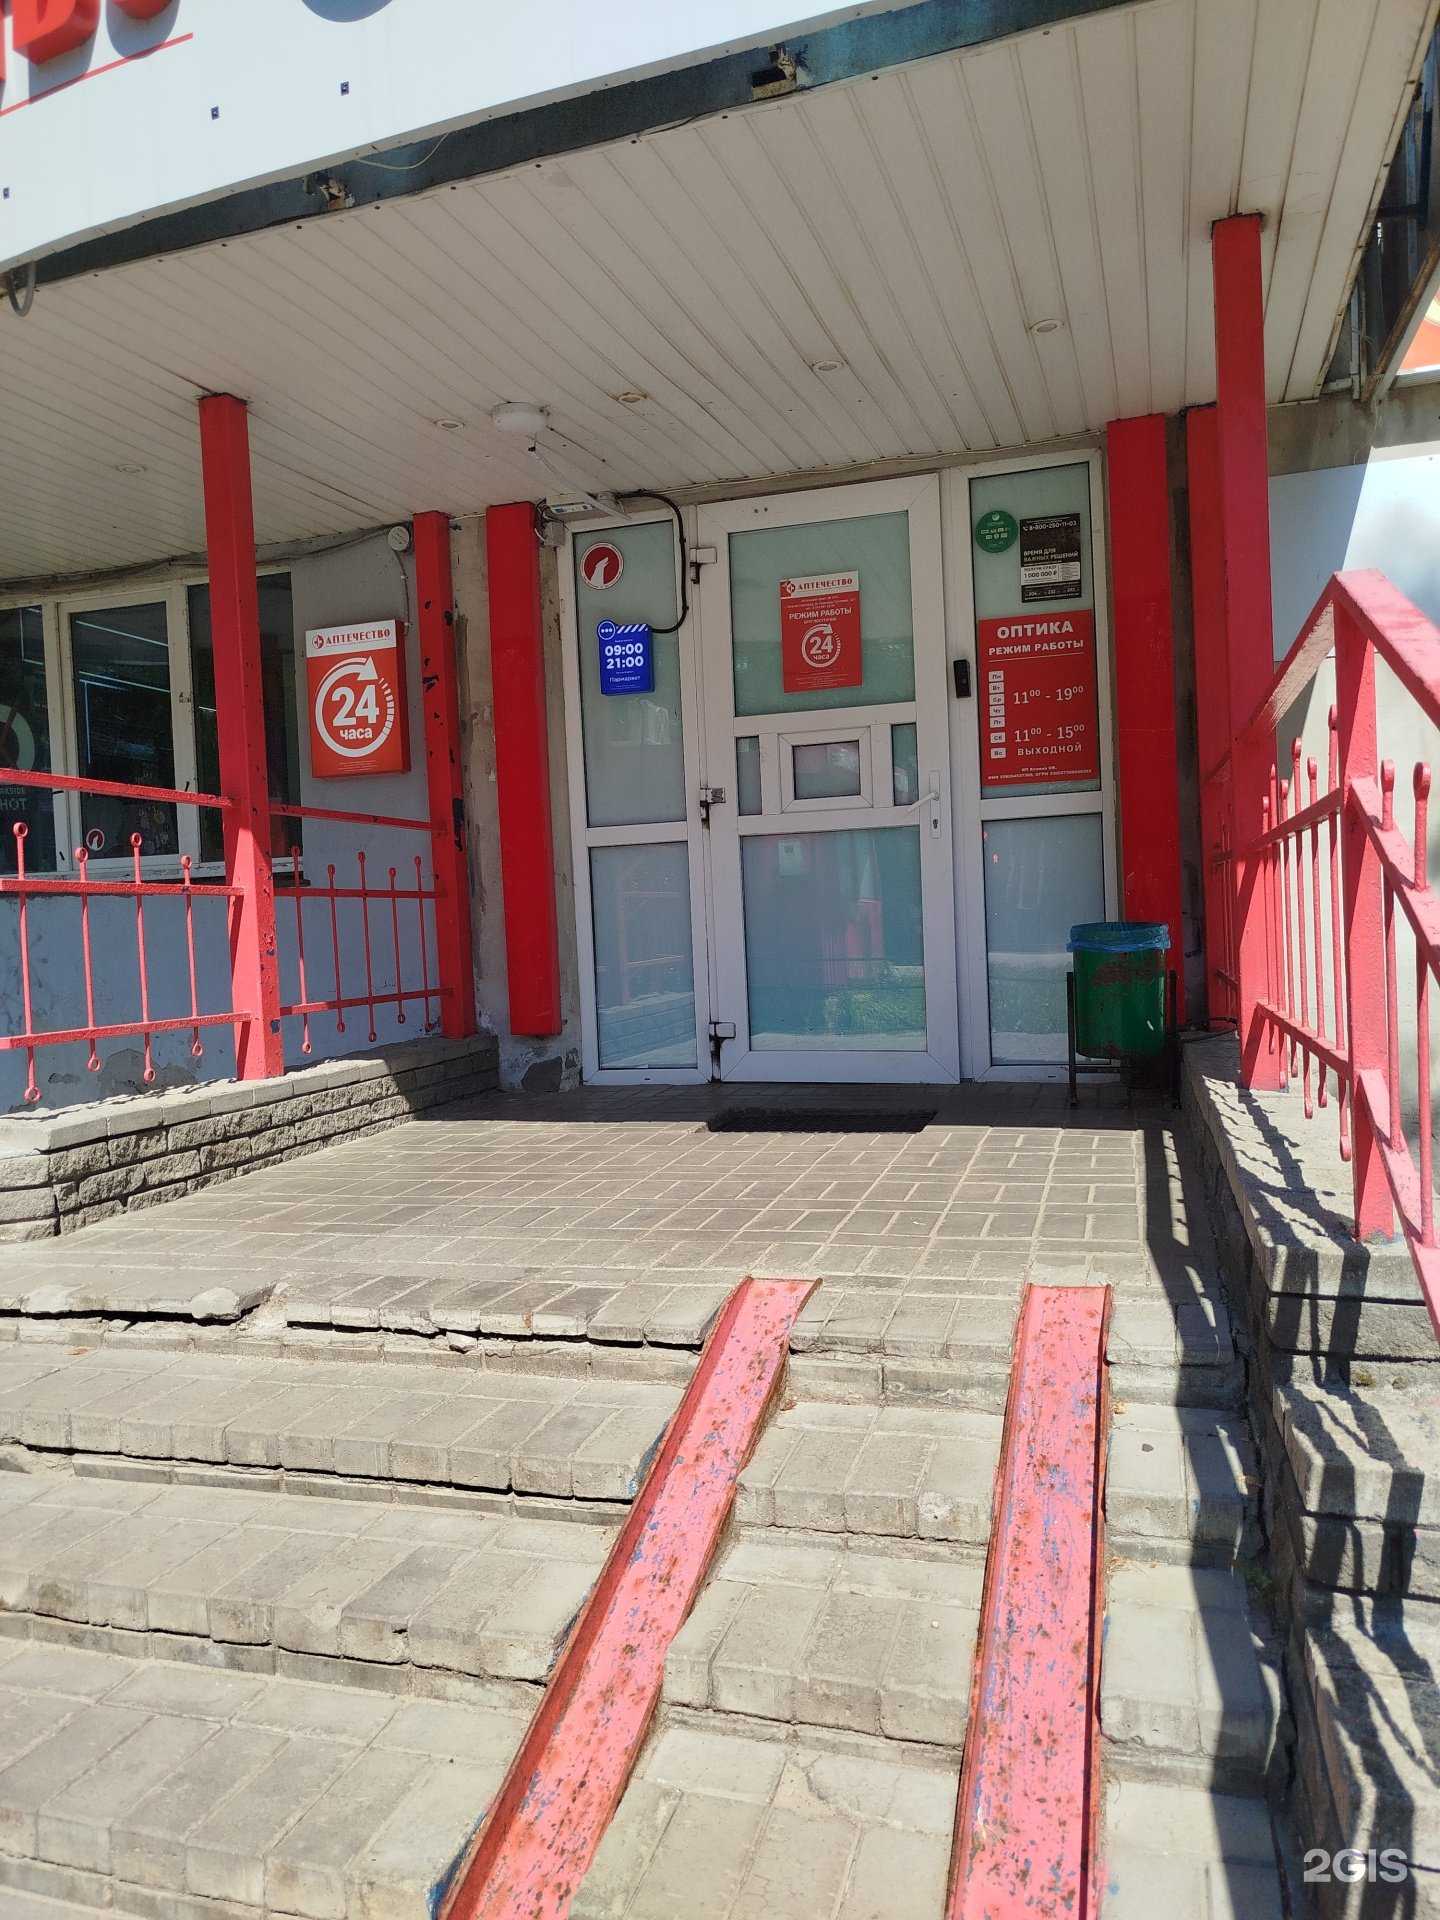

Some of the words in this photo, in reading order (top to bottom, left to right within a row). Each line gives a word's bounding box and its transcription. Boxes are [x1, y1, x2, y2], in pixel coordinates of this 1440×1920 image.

[798, 578, 853, 591] АПТЕЧЕСТВО
[789, 610, 819, 620] РЕЖИМ
[820, 607, 852, 617] РАБОТЫ
[326, 629, 390, 644] АПТЕЧЕСТВО
[997, 620, 1074, 639] ОПТИКА
[605, 643, 643, 656] 09:00
[809, 635, 834, 654] 24
[988, 644, 1031, 656] РЕЖИМ
[1034, 640, 1084, 652] РАБОТЫ
[606, 656, 644, 669] 21:00
[331, 684, 380, 727] 24
[340, 727, 373, 741] часа
[1017, 742, 1082, 756] ВЫХОДНОЙ
